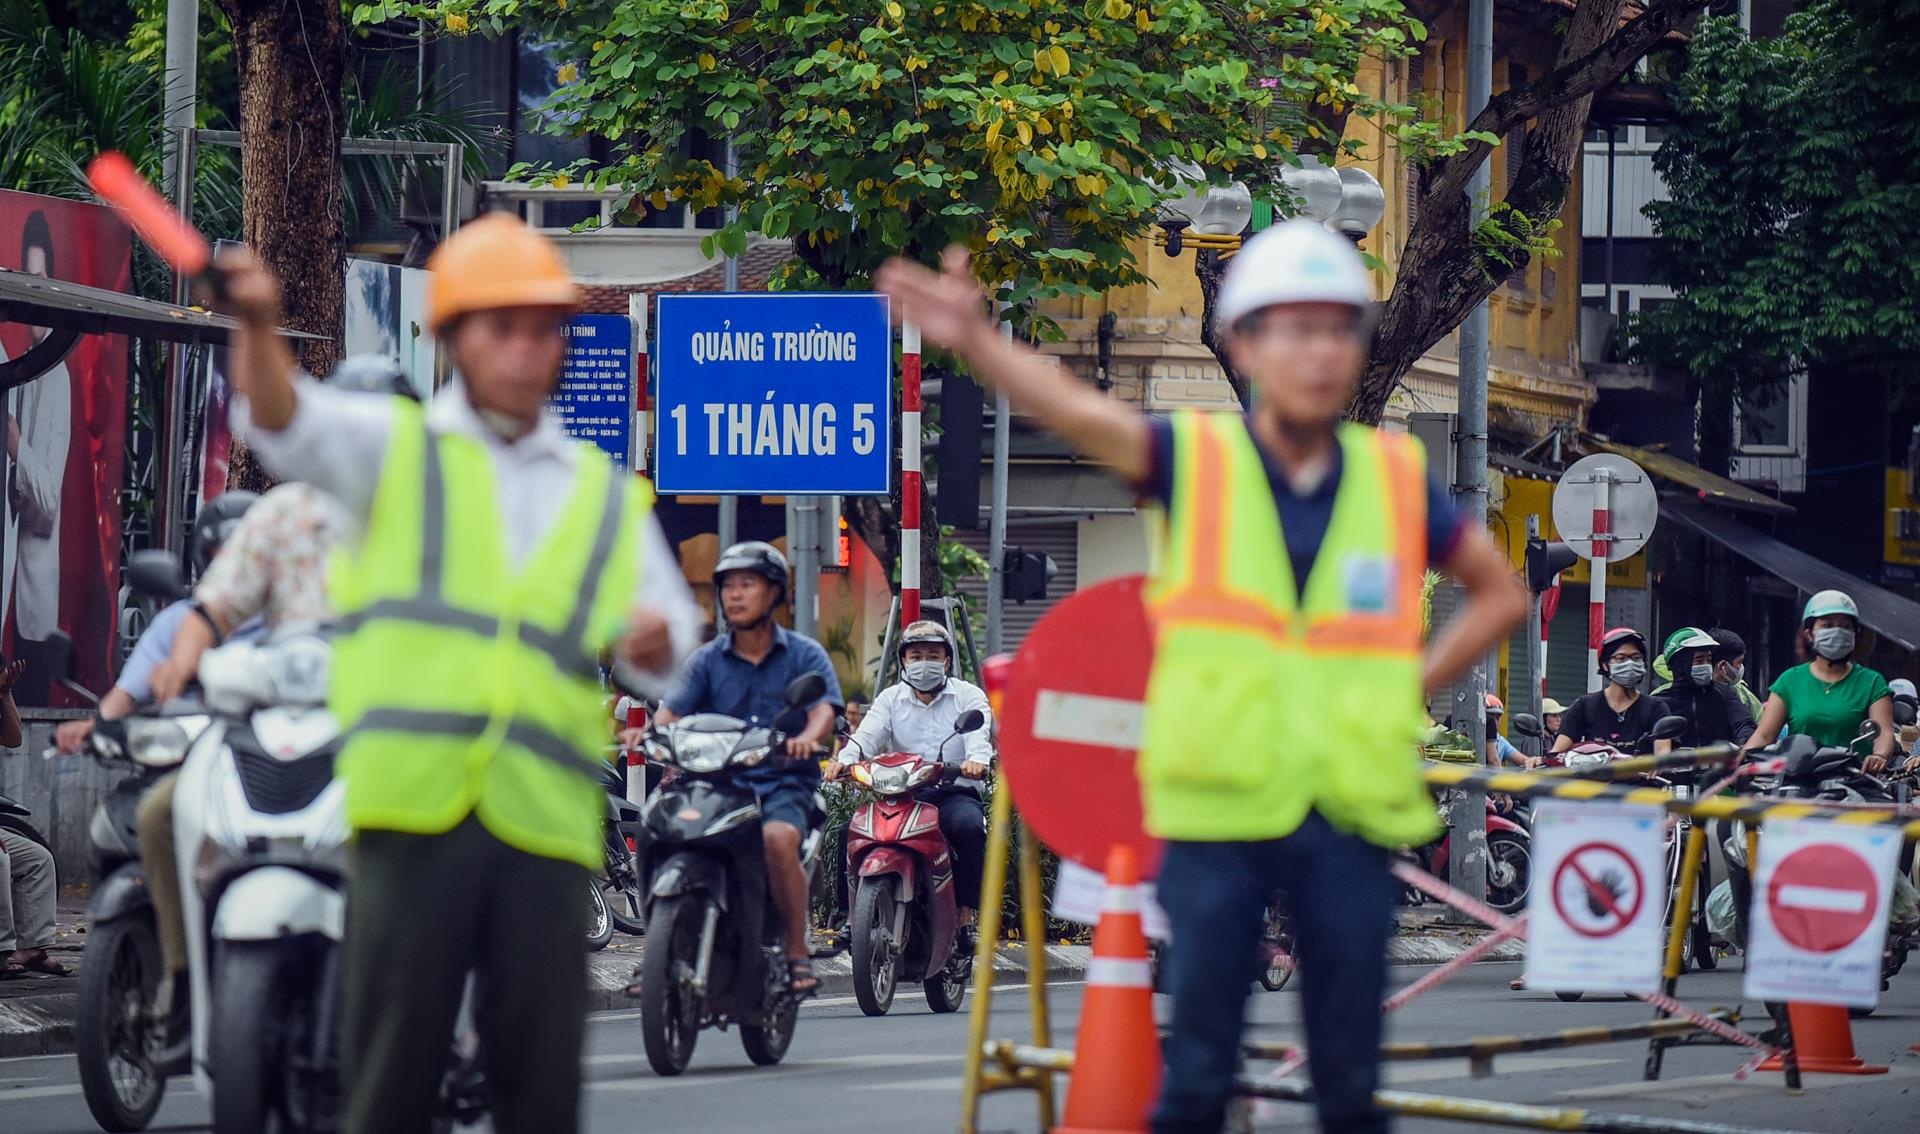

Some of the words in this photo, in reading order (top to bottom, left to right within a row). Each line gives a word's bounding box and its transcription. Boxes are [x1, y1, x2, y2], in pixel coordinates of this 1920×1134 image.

[572, 323, 597, 337] TRÌNH
[691, 319, 764, 365] QUẢNG
[772, 322, 857, 362] TRƯỜNG
[671, 404, 687, 455] 1
[704, 390, 837, 456] THÁNG
[852, 403, 875, 455] 5
